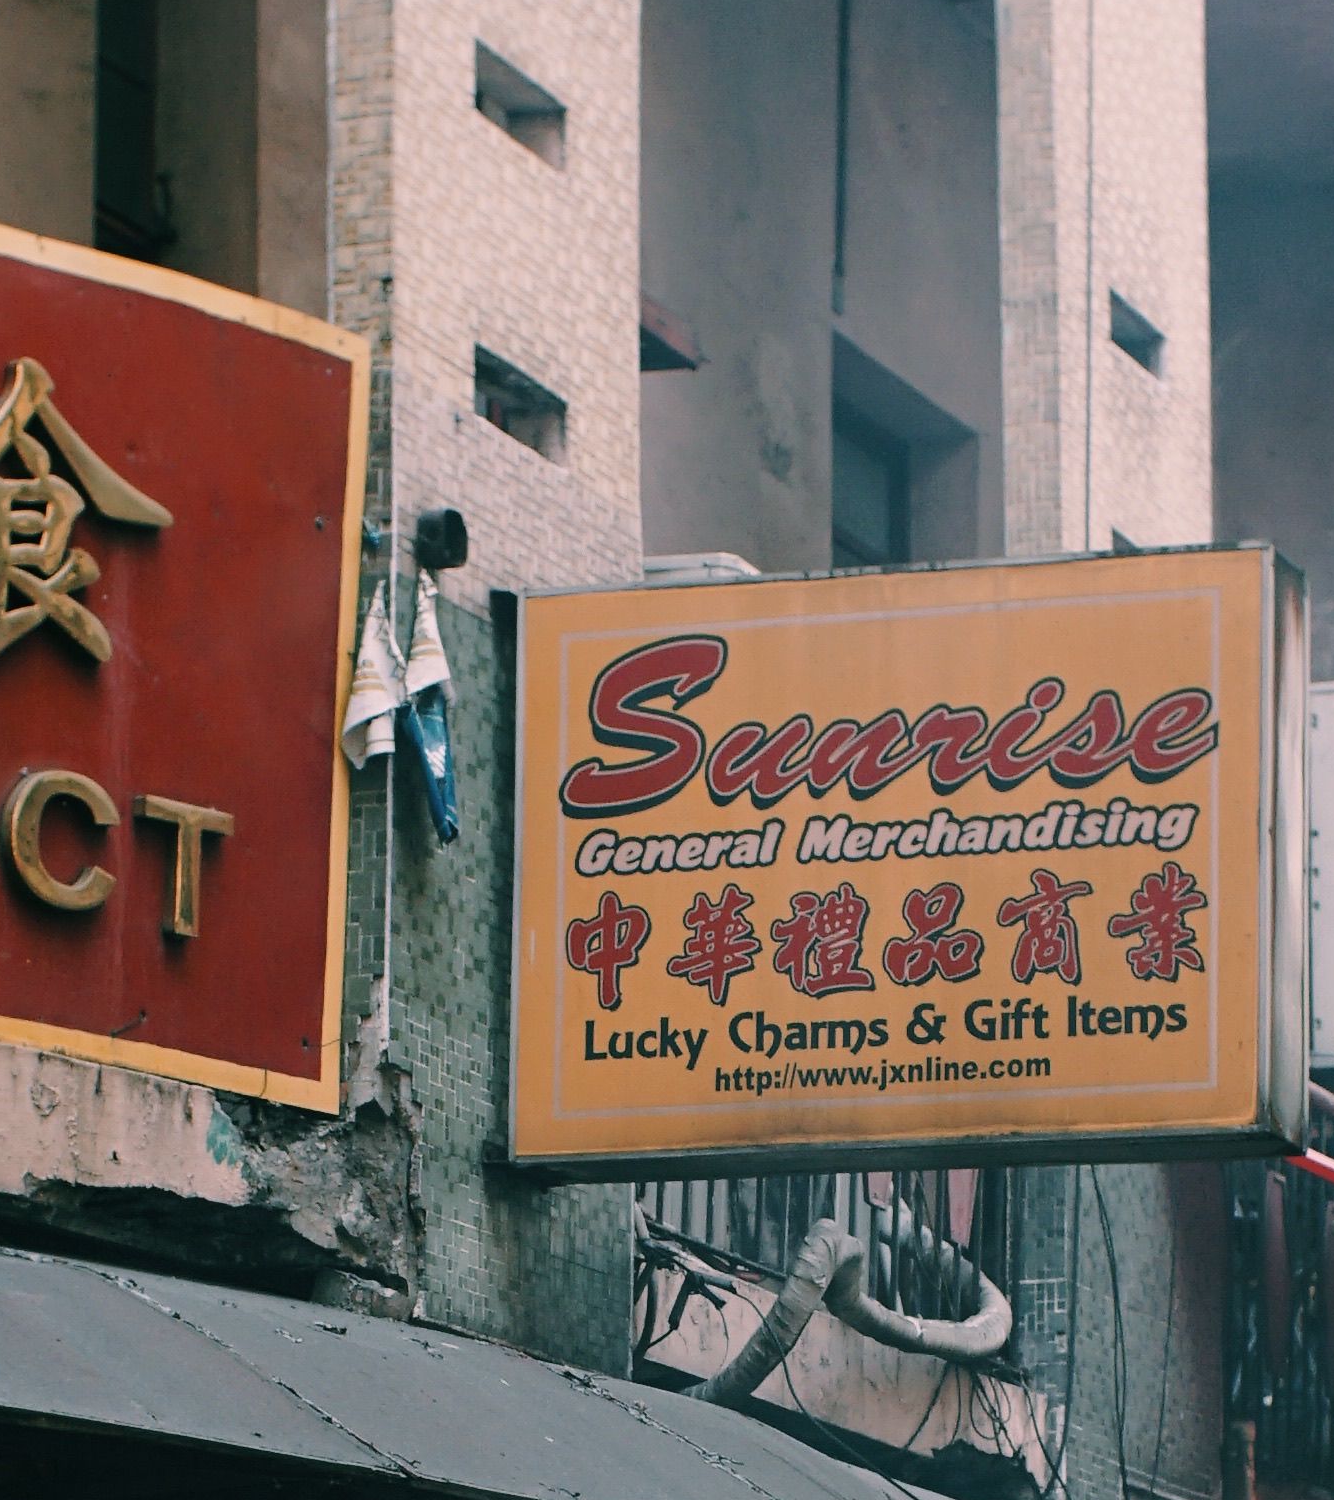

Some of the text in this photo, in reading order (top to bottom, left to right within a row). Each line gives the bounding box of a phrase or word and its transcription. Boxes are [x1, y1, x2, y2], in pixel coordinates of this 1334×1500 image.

[559, 634, 1220, 817] Sunrise
[575, 798, 1199, 877] General Merchandising
[565, 862, 1209, 1010] 中華禮品商業
[584, 994, 1188, 1070] Lucky Charms & Gift Items
[714, 1052, 1052, 1095] http://www.jxnline.com
